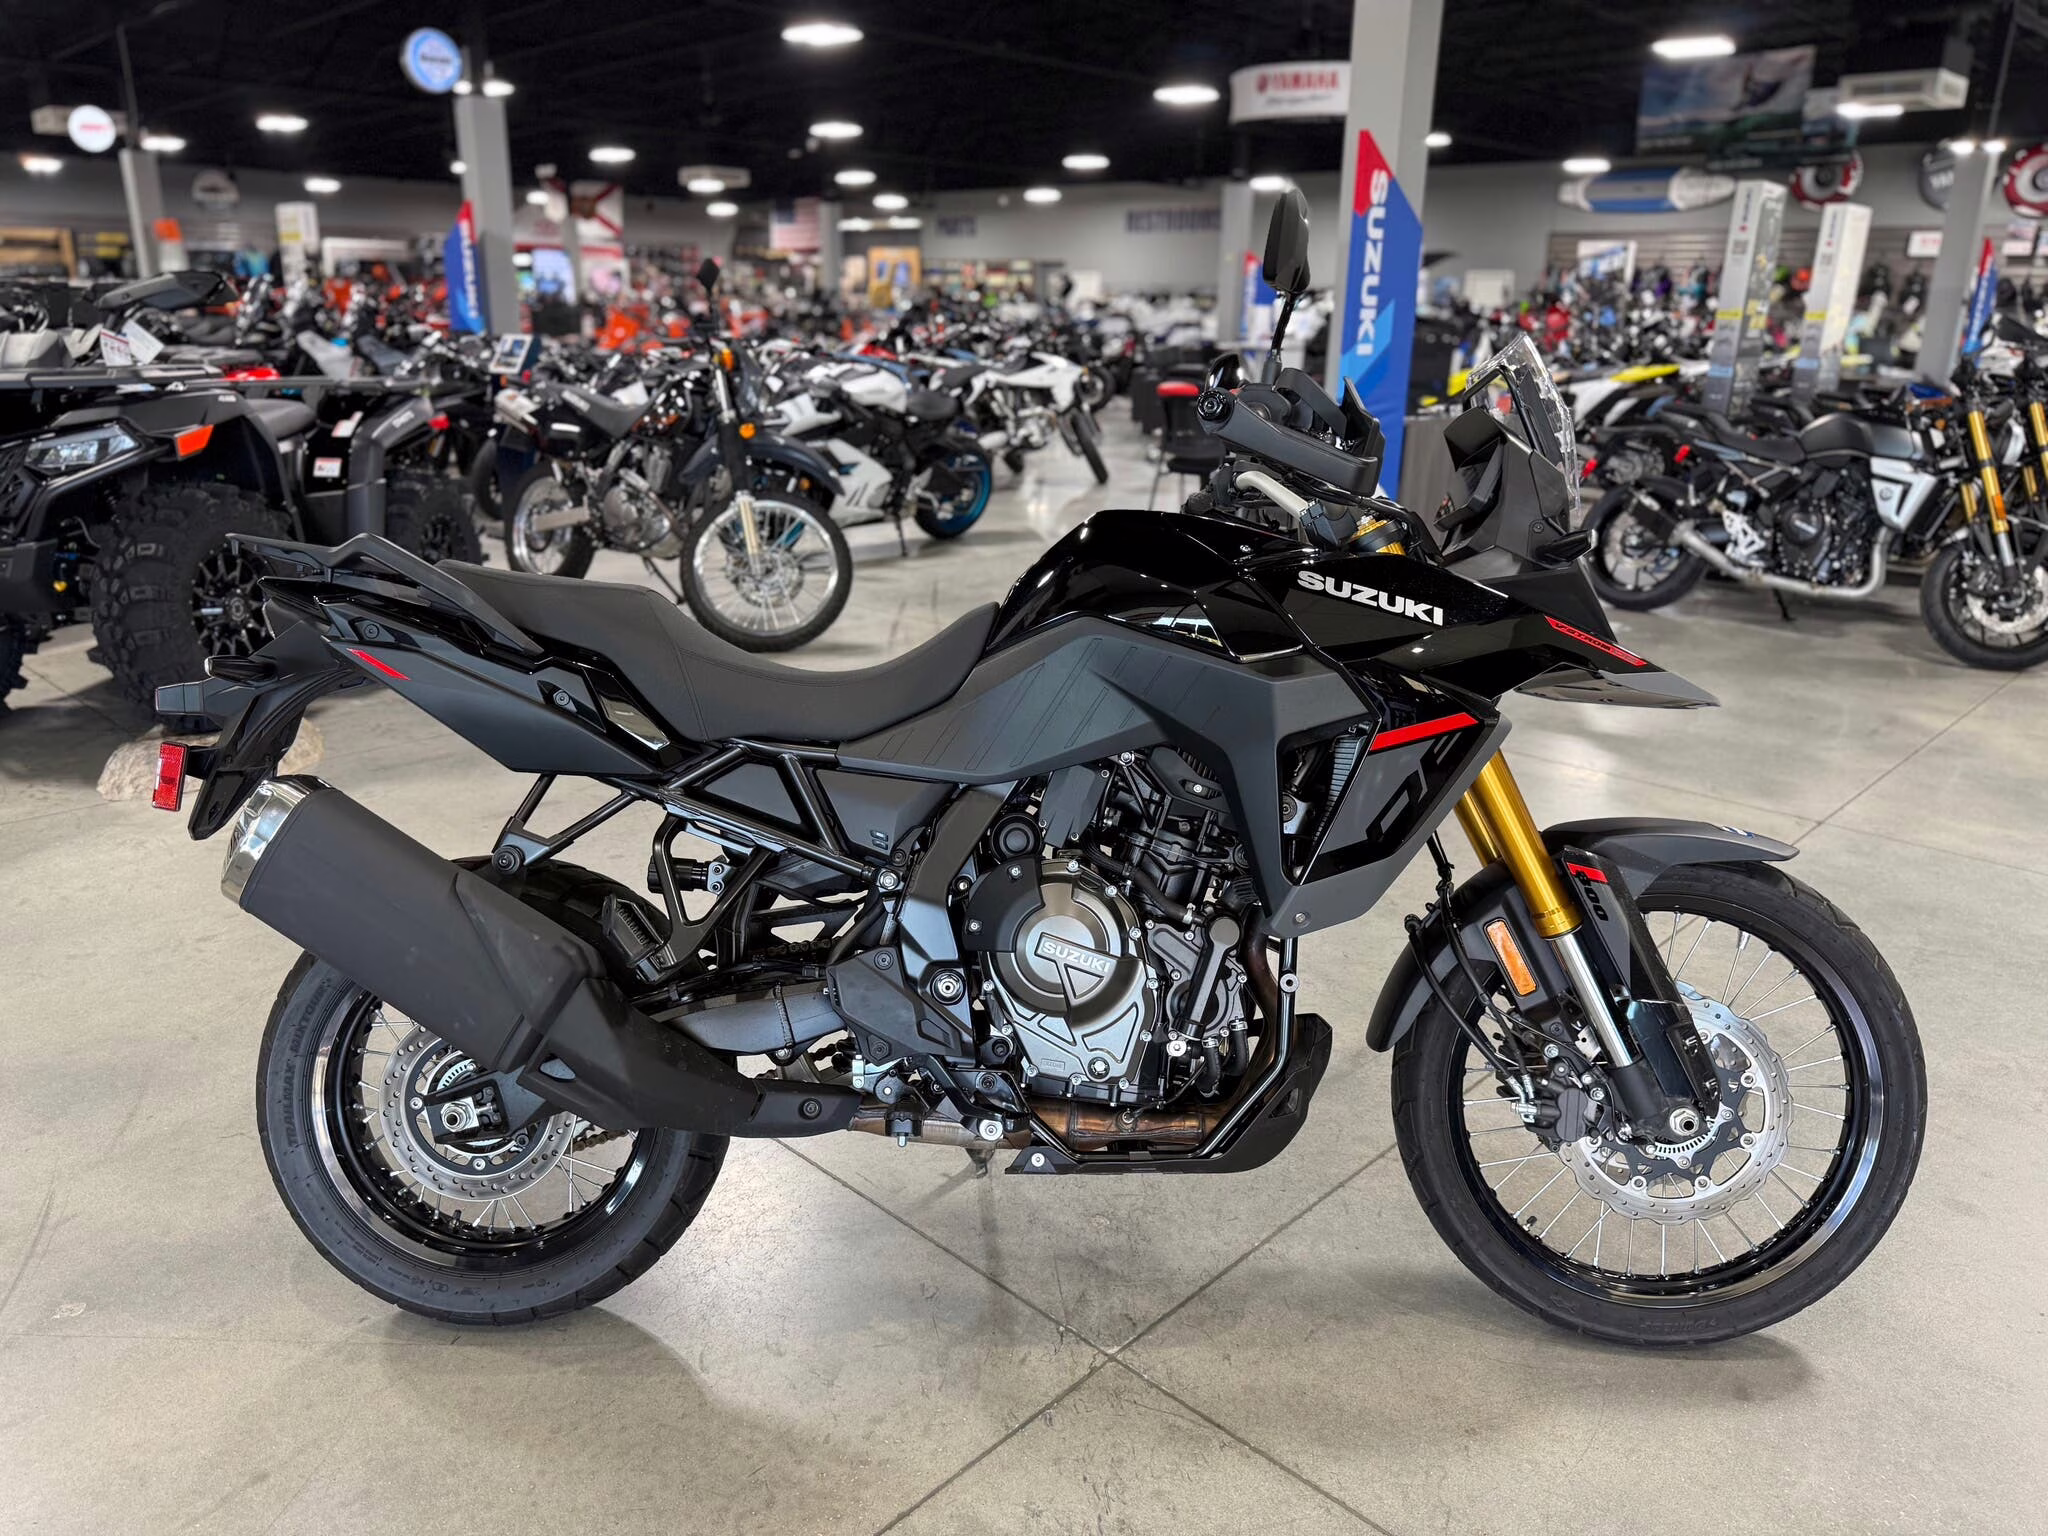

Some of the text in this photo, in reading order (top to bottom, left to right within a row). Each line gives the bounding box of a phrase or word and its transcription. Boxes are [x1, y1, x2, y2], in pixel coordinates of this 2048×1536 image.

[1356, 168, 1389, 356] SUZUKI
[1297, 570, 1443, 626] SUZUKI
[1576, 871, 1609, 921] 800
[1042, 941, 1111, 972] SUZUKI
[282, 1060, 300, 1148] TRAILMAX
